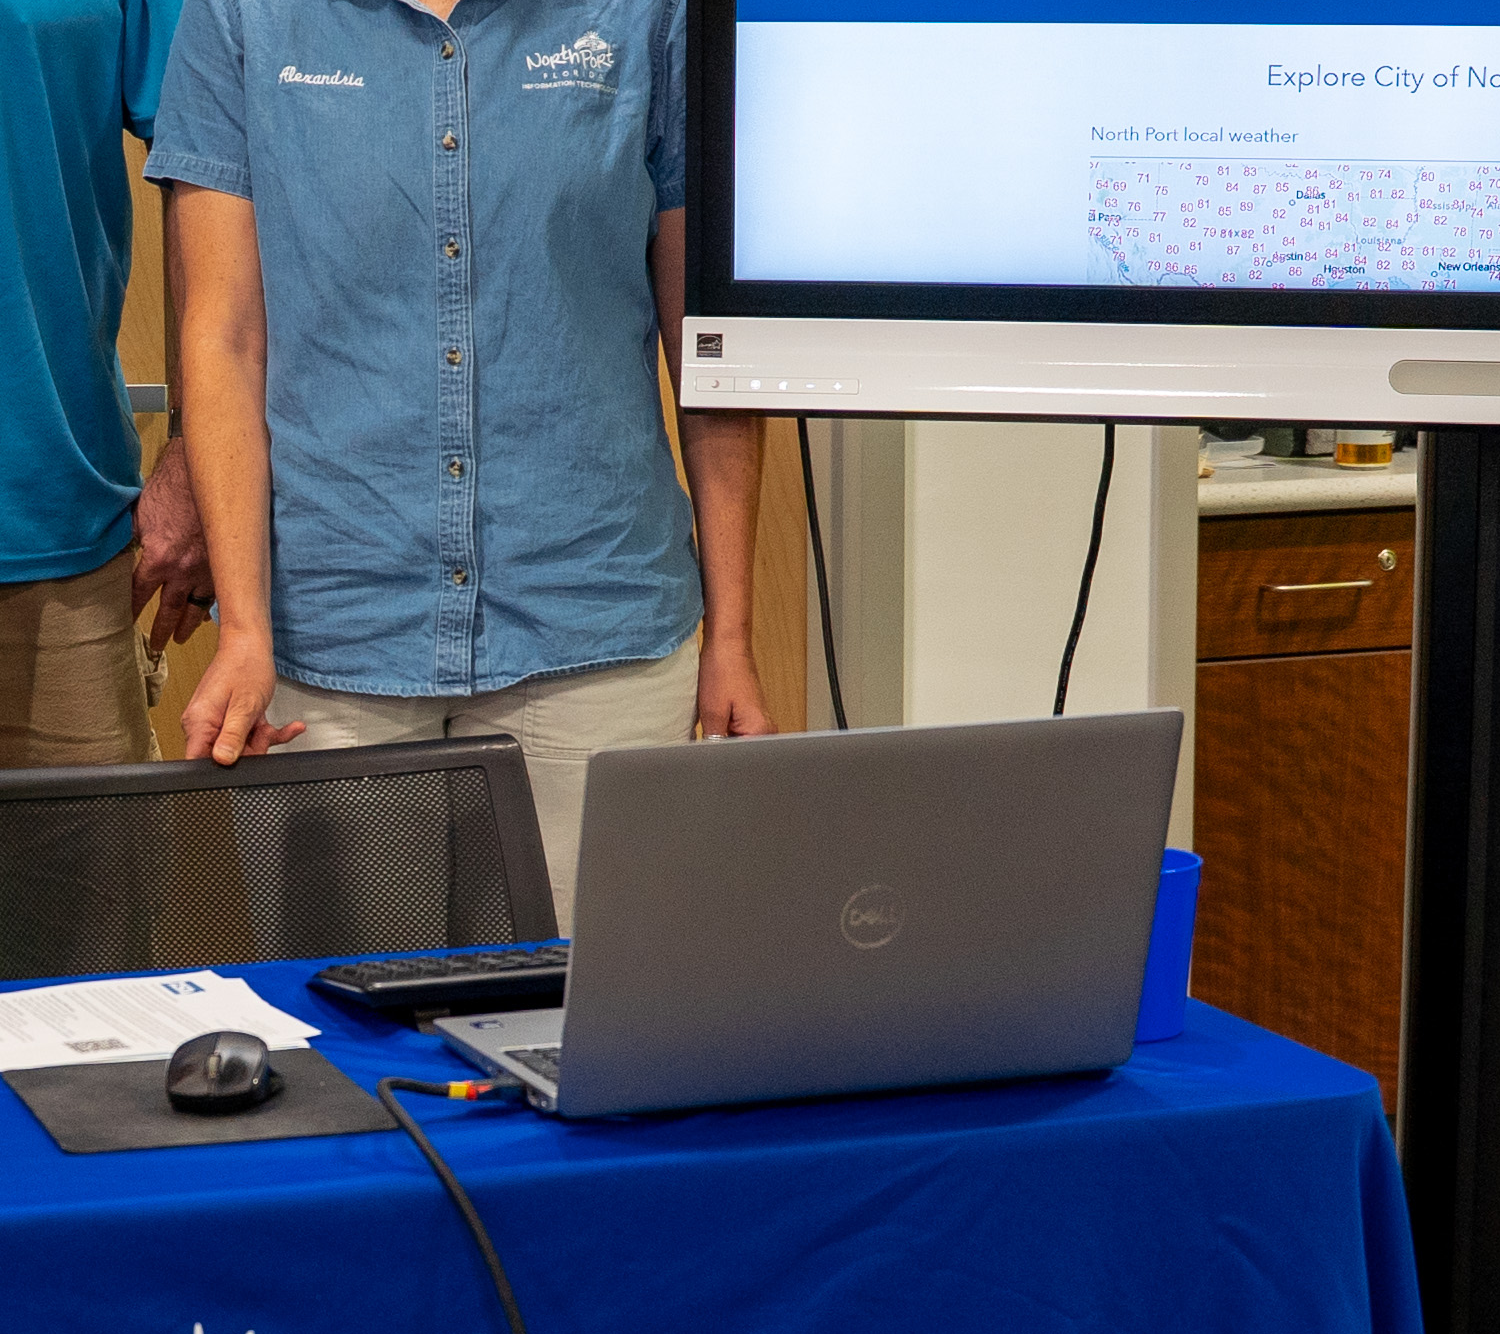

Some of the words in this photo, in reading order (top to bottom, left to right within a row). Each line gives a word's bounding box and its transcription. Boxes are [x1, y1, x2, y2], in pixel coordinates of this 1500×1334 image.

[277, 66, 366, 88] Alexandria
[1267, 63, 1366, 93] Explore
[1374, 65, 1425, 94] City
[1432, 64, 1461, 88] of
[1091, 125, 1140, 142] North
[1145, 126, 1178, 142] Port
[1183, 126, 1224, 143] local
[1228, 127, 1299, 143] weather
